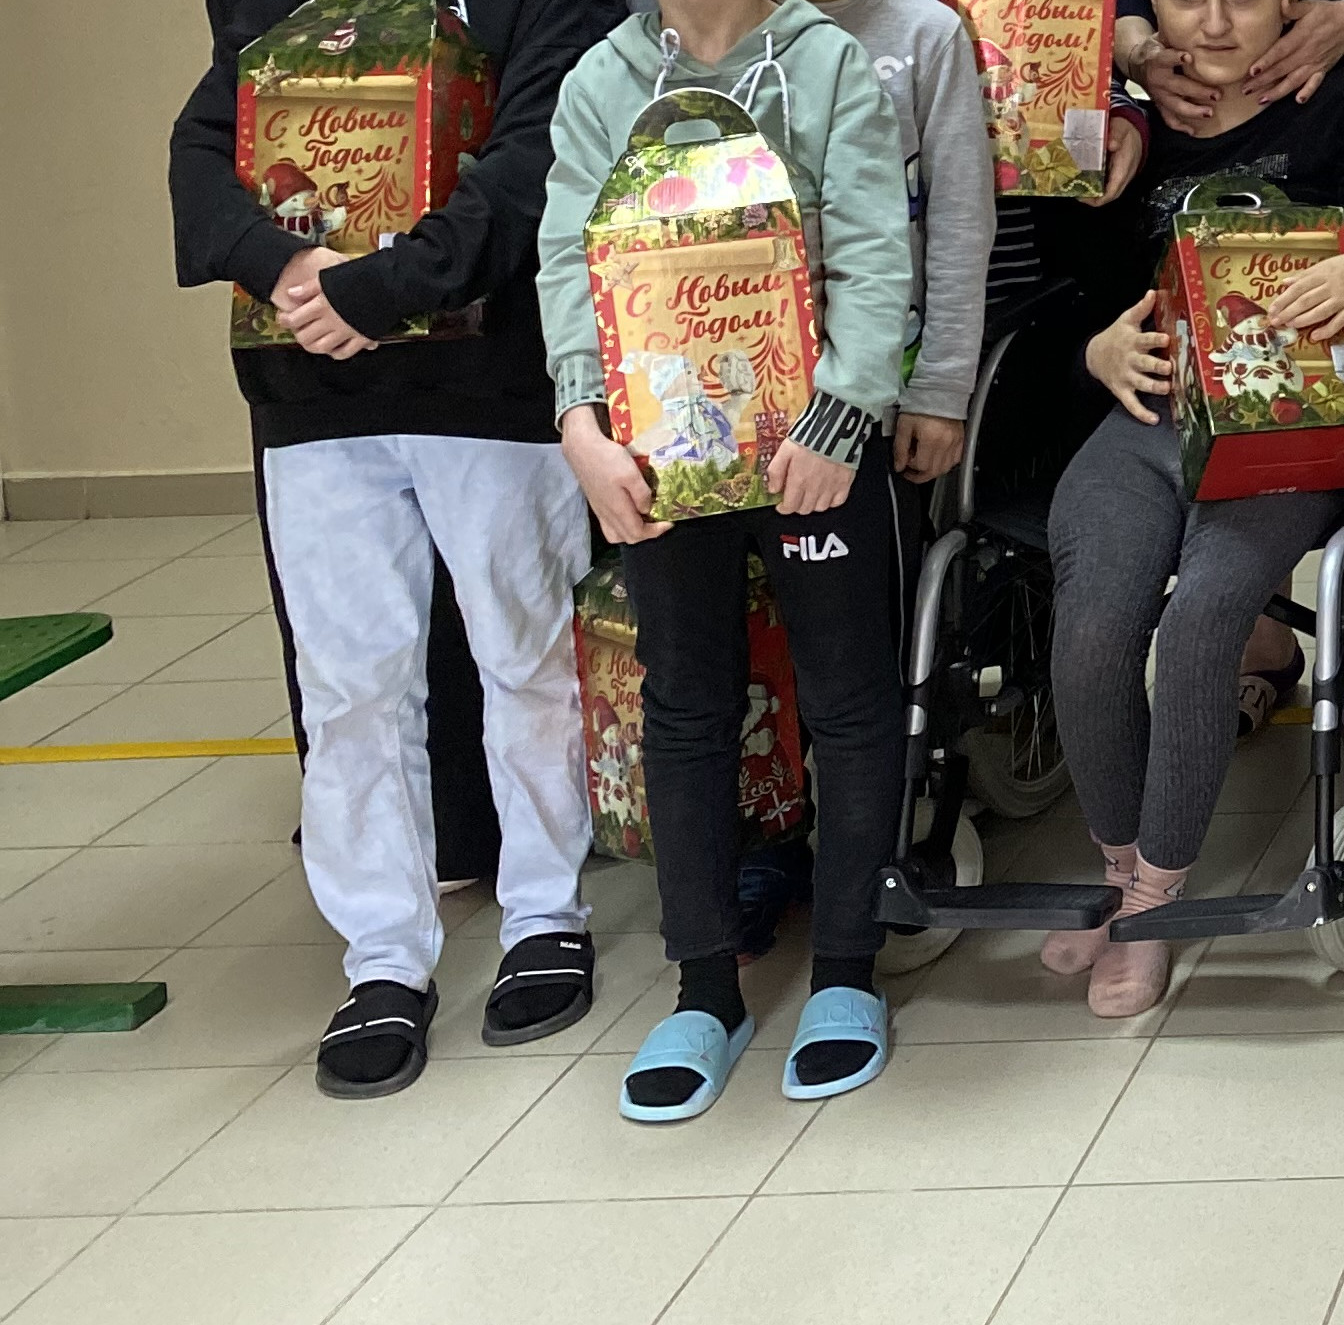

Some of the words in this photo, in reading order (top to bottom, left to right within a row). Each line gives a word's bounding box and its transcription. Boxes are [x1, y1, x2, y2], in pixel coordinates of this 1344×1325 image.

[1000, 22, 1096, 54] Годом!
[299, 106, 407, 140] Новым
[303, 137, 409, 173] Годом!
[666, 273, 785, 311] Новым
[676, 299, 789, 346] Годом!
[780, 533, 849, 561] FILA
